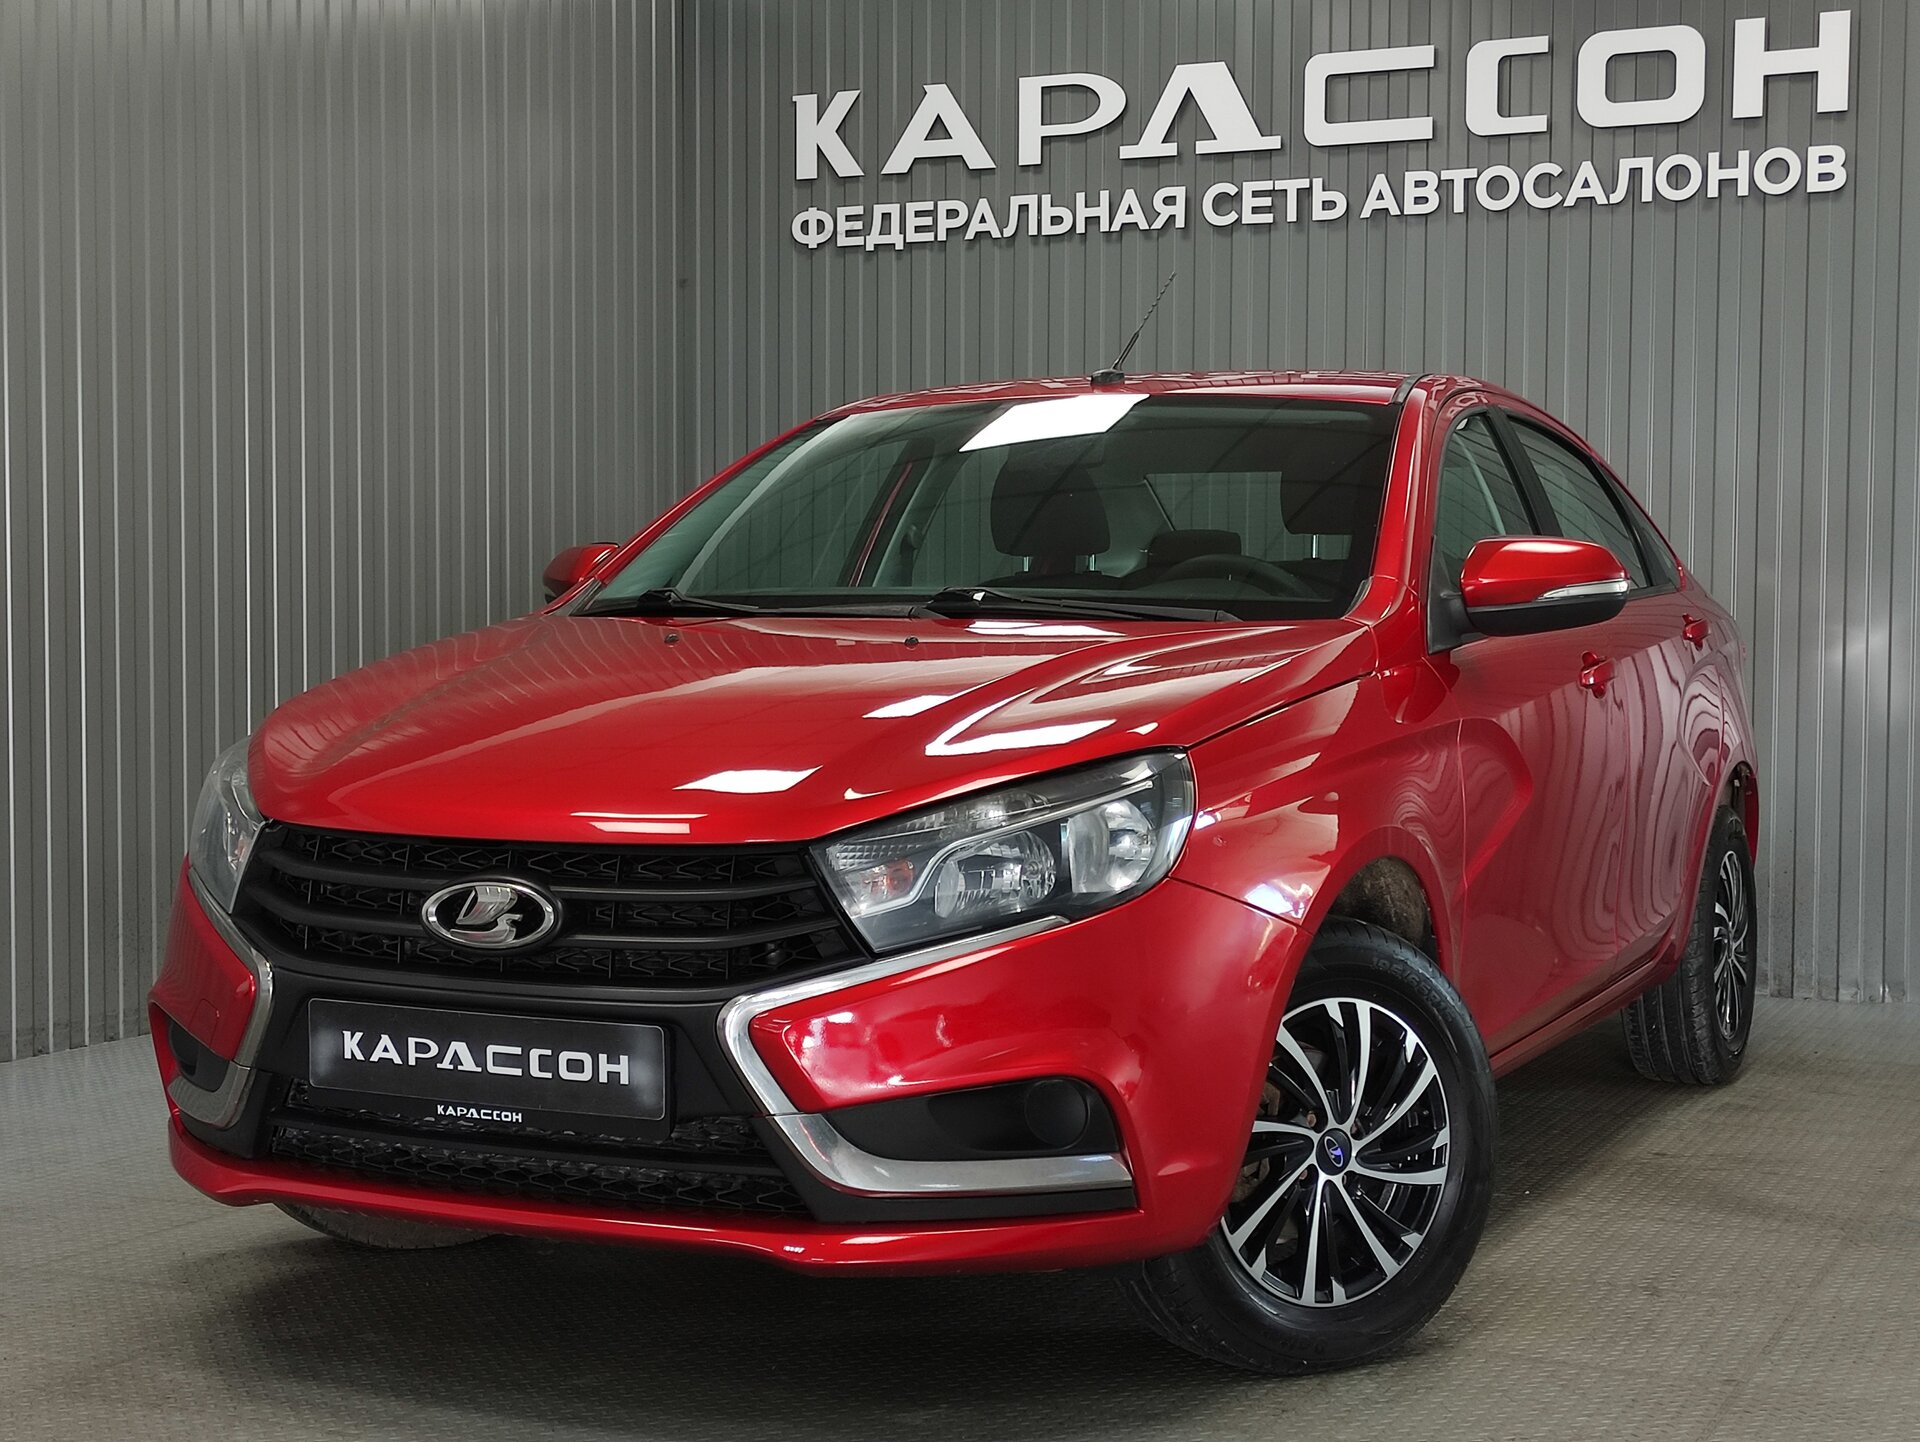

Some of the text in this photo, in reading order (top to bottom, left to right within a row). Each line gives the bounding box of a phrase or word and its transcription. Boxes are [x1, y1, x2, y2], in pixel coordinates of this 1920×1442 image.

[791, 145, 1847, 251] ФЕДЕРАЛЬНАЯ СЕТЬ АВТОСАЛОНОВ
